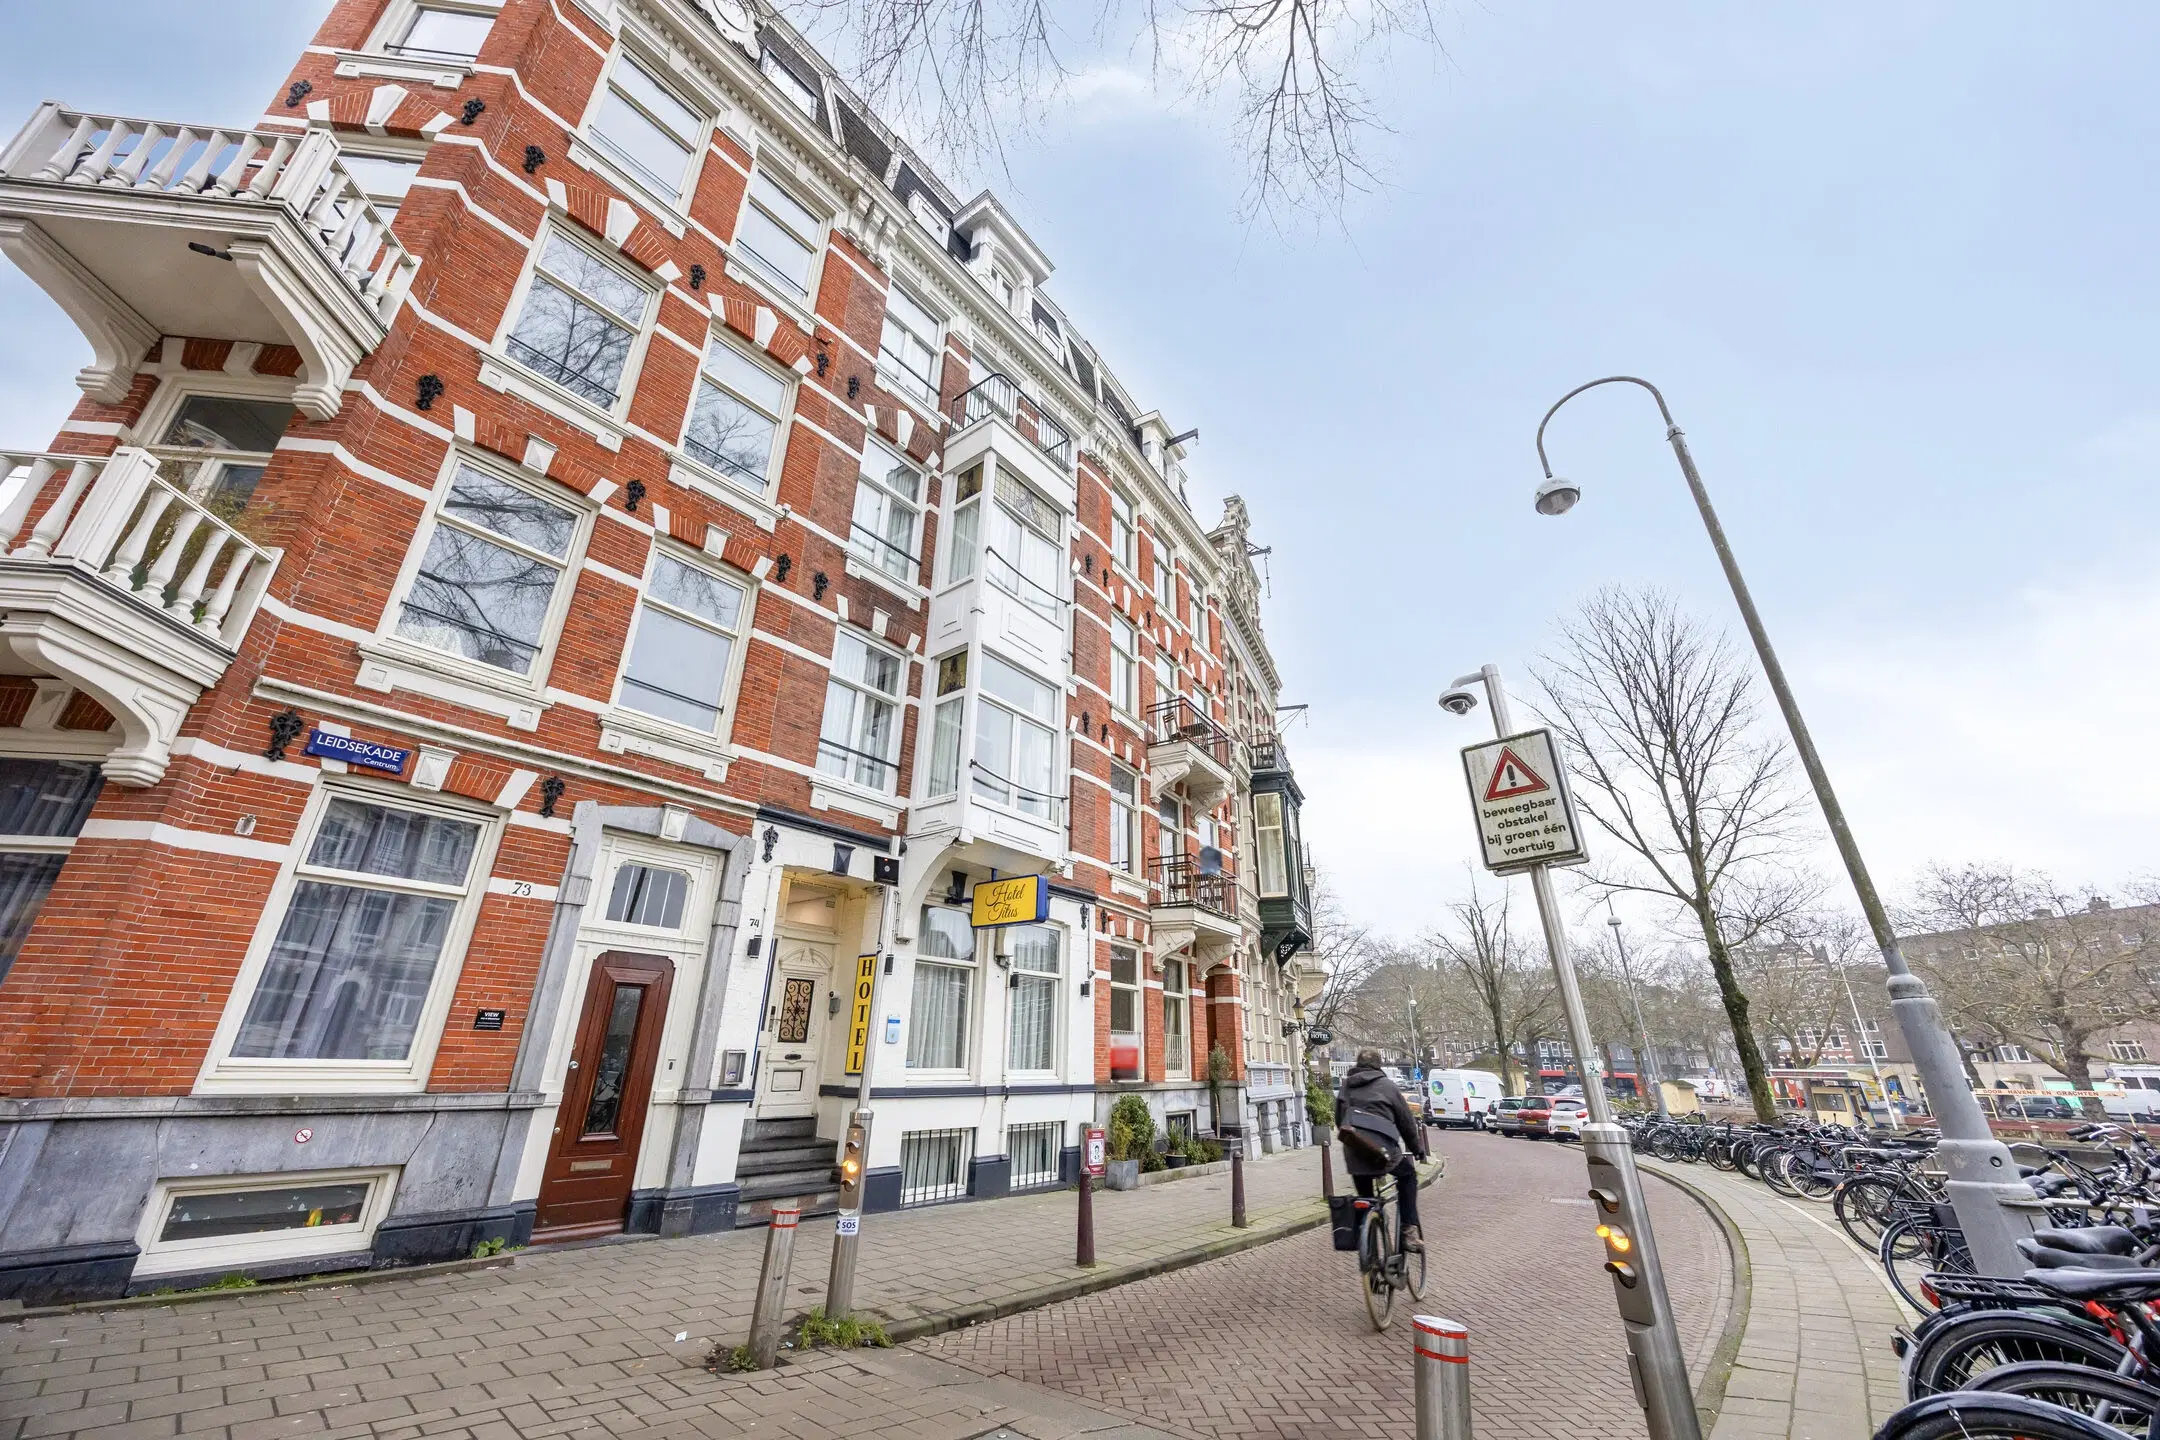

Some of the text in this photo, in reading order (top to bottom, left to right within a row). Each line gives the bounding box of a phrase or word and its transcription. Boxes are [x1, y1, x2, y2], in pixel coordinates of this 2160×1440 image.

[316, 734, 402, 762] LEIDSEKADE
[363, 757, 397, 771] Centrum
[1483, 798, 1557, 818] beweegbaar
[1498, 811, 1548, 829] obstakel
[1487, 824, 1566, 846] bij groen één
[1503, 840, 1555, 856] voertuig
[512, 881, 532, 896] 73
[985, 883, 1026, 907] Hotel
[988, 901, 1018, 921] Titus
[749, 918, 760, 928] 74
[852, 959, 873, 1071] HOTEL
[841, 1221, 856, 1229] SOS
